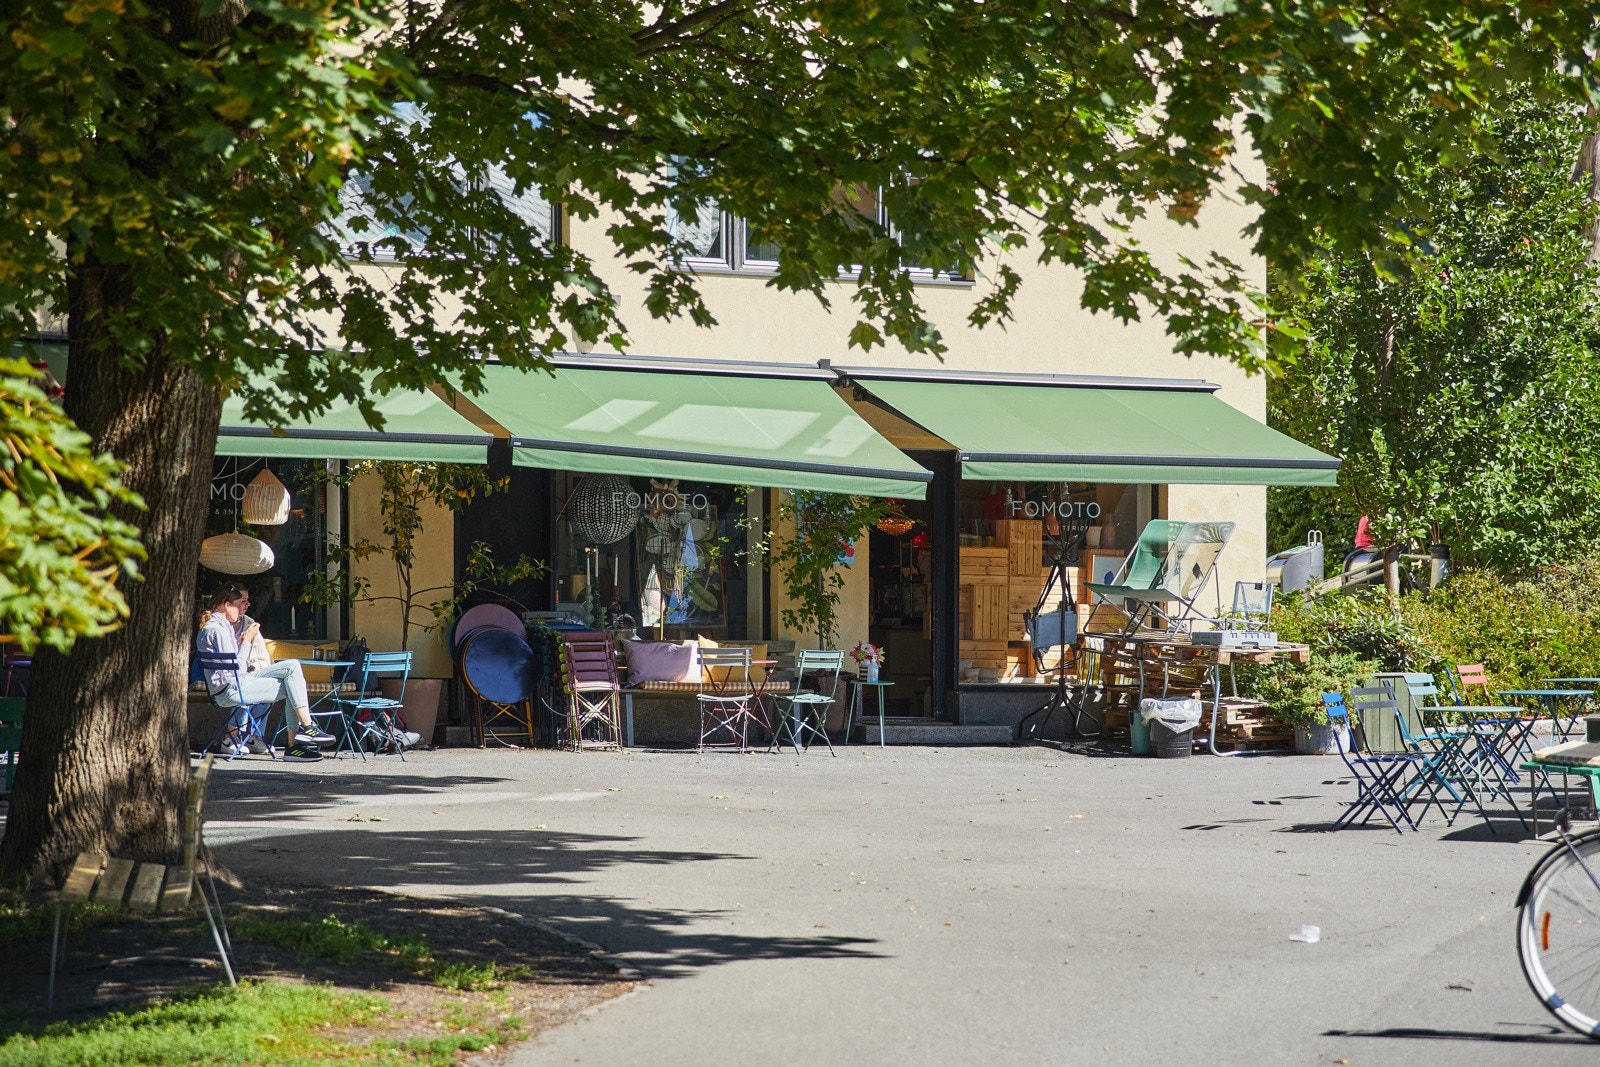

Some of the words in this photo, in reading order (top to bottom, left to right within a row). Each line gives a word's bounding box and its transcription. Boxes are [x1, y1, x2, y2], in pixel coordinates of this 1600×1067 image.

[210, 483, 279, 501] MOTO
[612, 492, 708, 510] FOMOTO
[1012, 501, 1101, 519] FOMOTO
